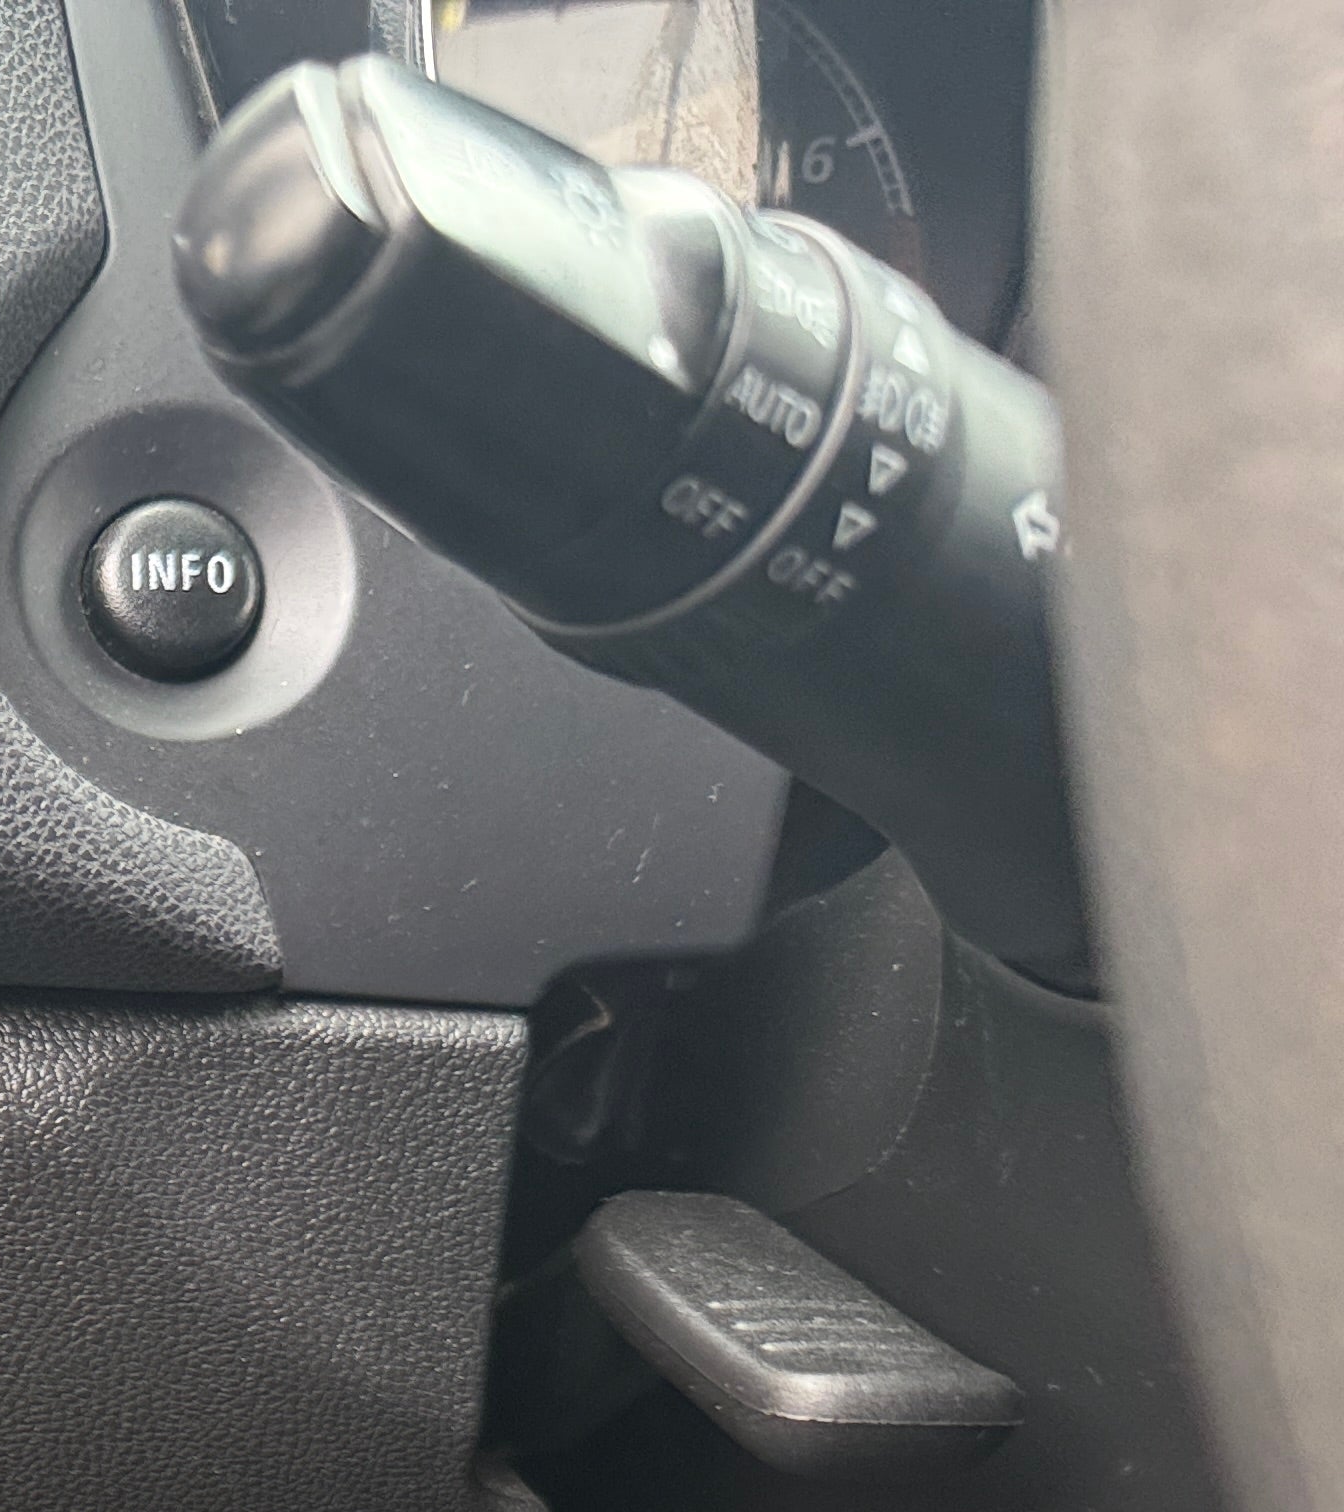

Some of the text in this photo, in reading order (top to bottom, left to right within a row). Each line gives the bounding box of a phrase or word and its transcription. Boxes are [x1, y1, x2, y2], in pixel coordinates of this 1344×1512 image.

[800, 136, 836, 185] 6
[723, 362, 822, 450] AUTO
[662, 475, 749, 539] OFF
[130, 551, 236, 594] INFO
[767, 547, 857, 604] OFF
